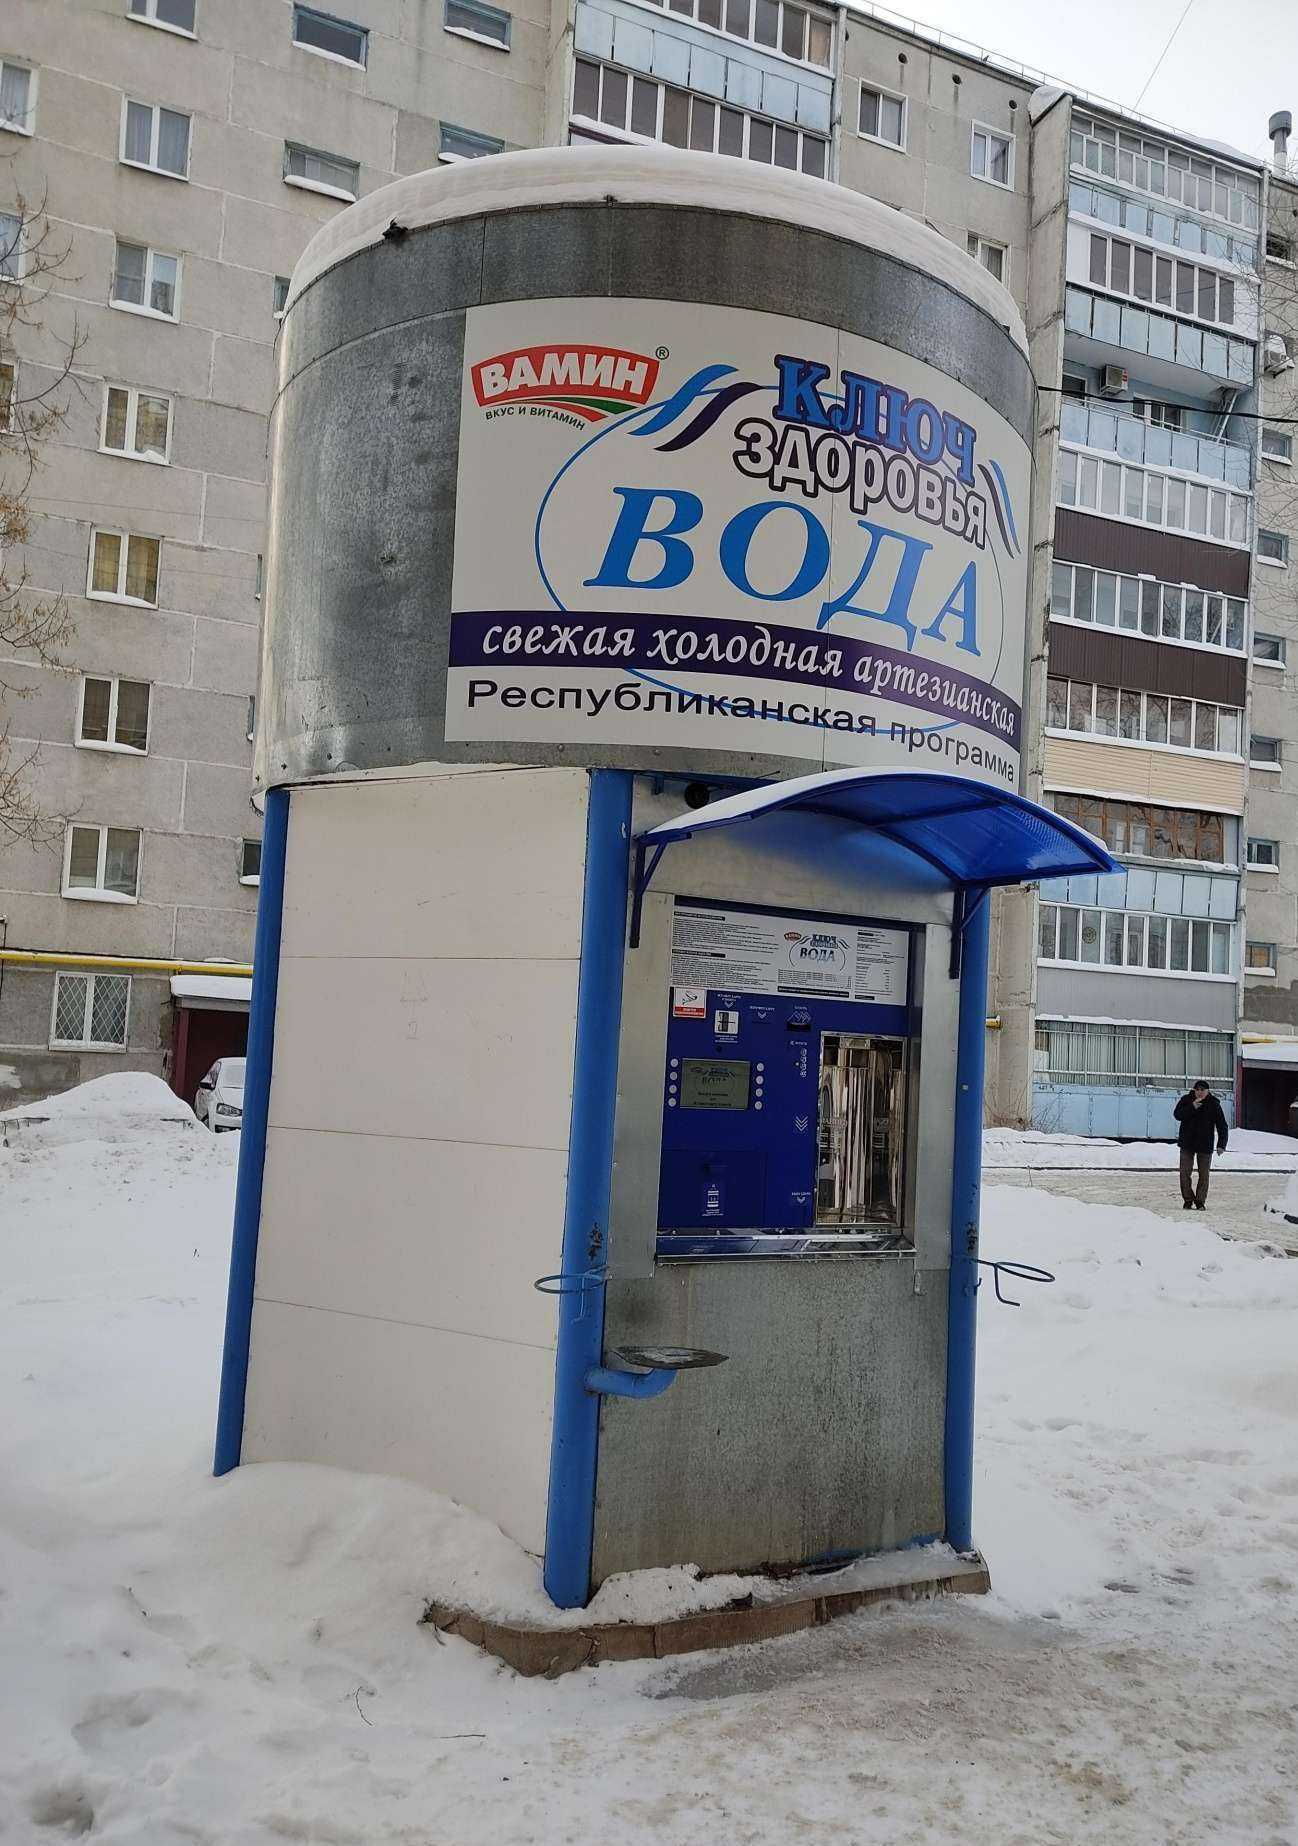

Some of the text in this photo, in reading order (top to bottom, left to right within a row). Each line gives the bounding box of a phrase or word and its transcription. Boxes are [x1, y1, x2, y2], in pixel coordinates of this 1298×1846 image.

[480, 352, 648, 399] ВАМИН
[485, 406, 586, 431] ВКУС И ВИТАМИН
[772, 354, 977, 488] КЛЮЧ
[582, 486, 982, 657] ВОДА
[467, 679, 1015, 784] Республиканская программа
[482, 624, 1016, 737] свежая холодная артезианская
[799, 947, 836, 963] ВОДА
